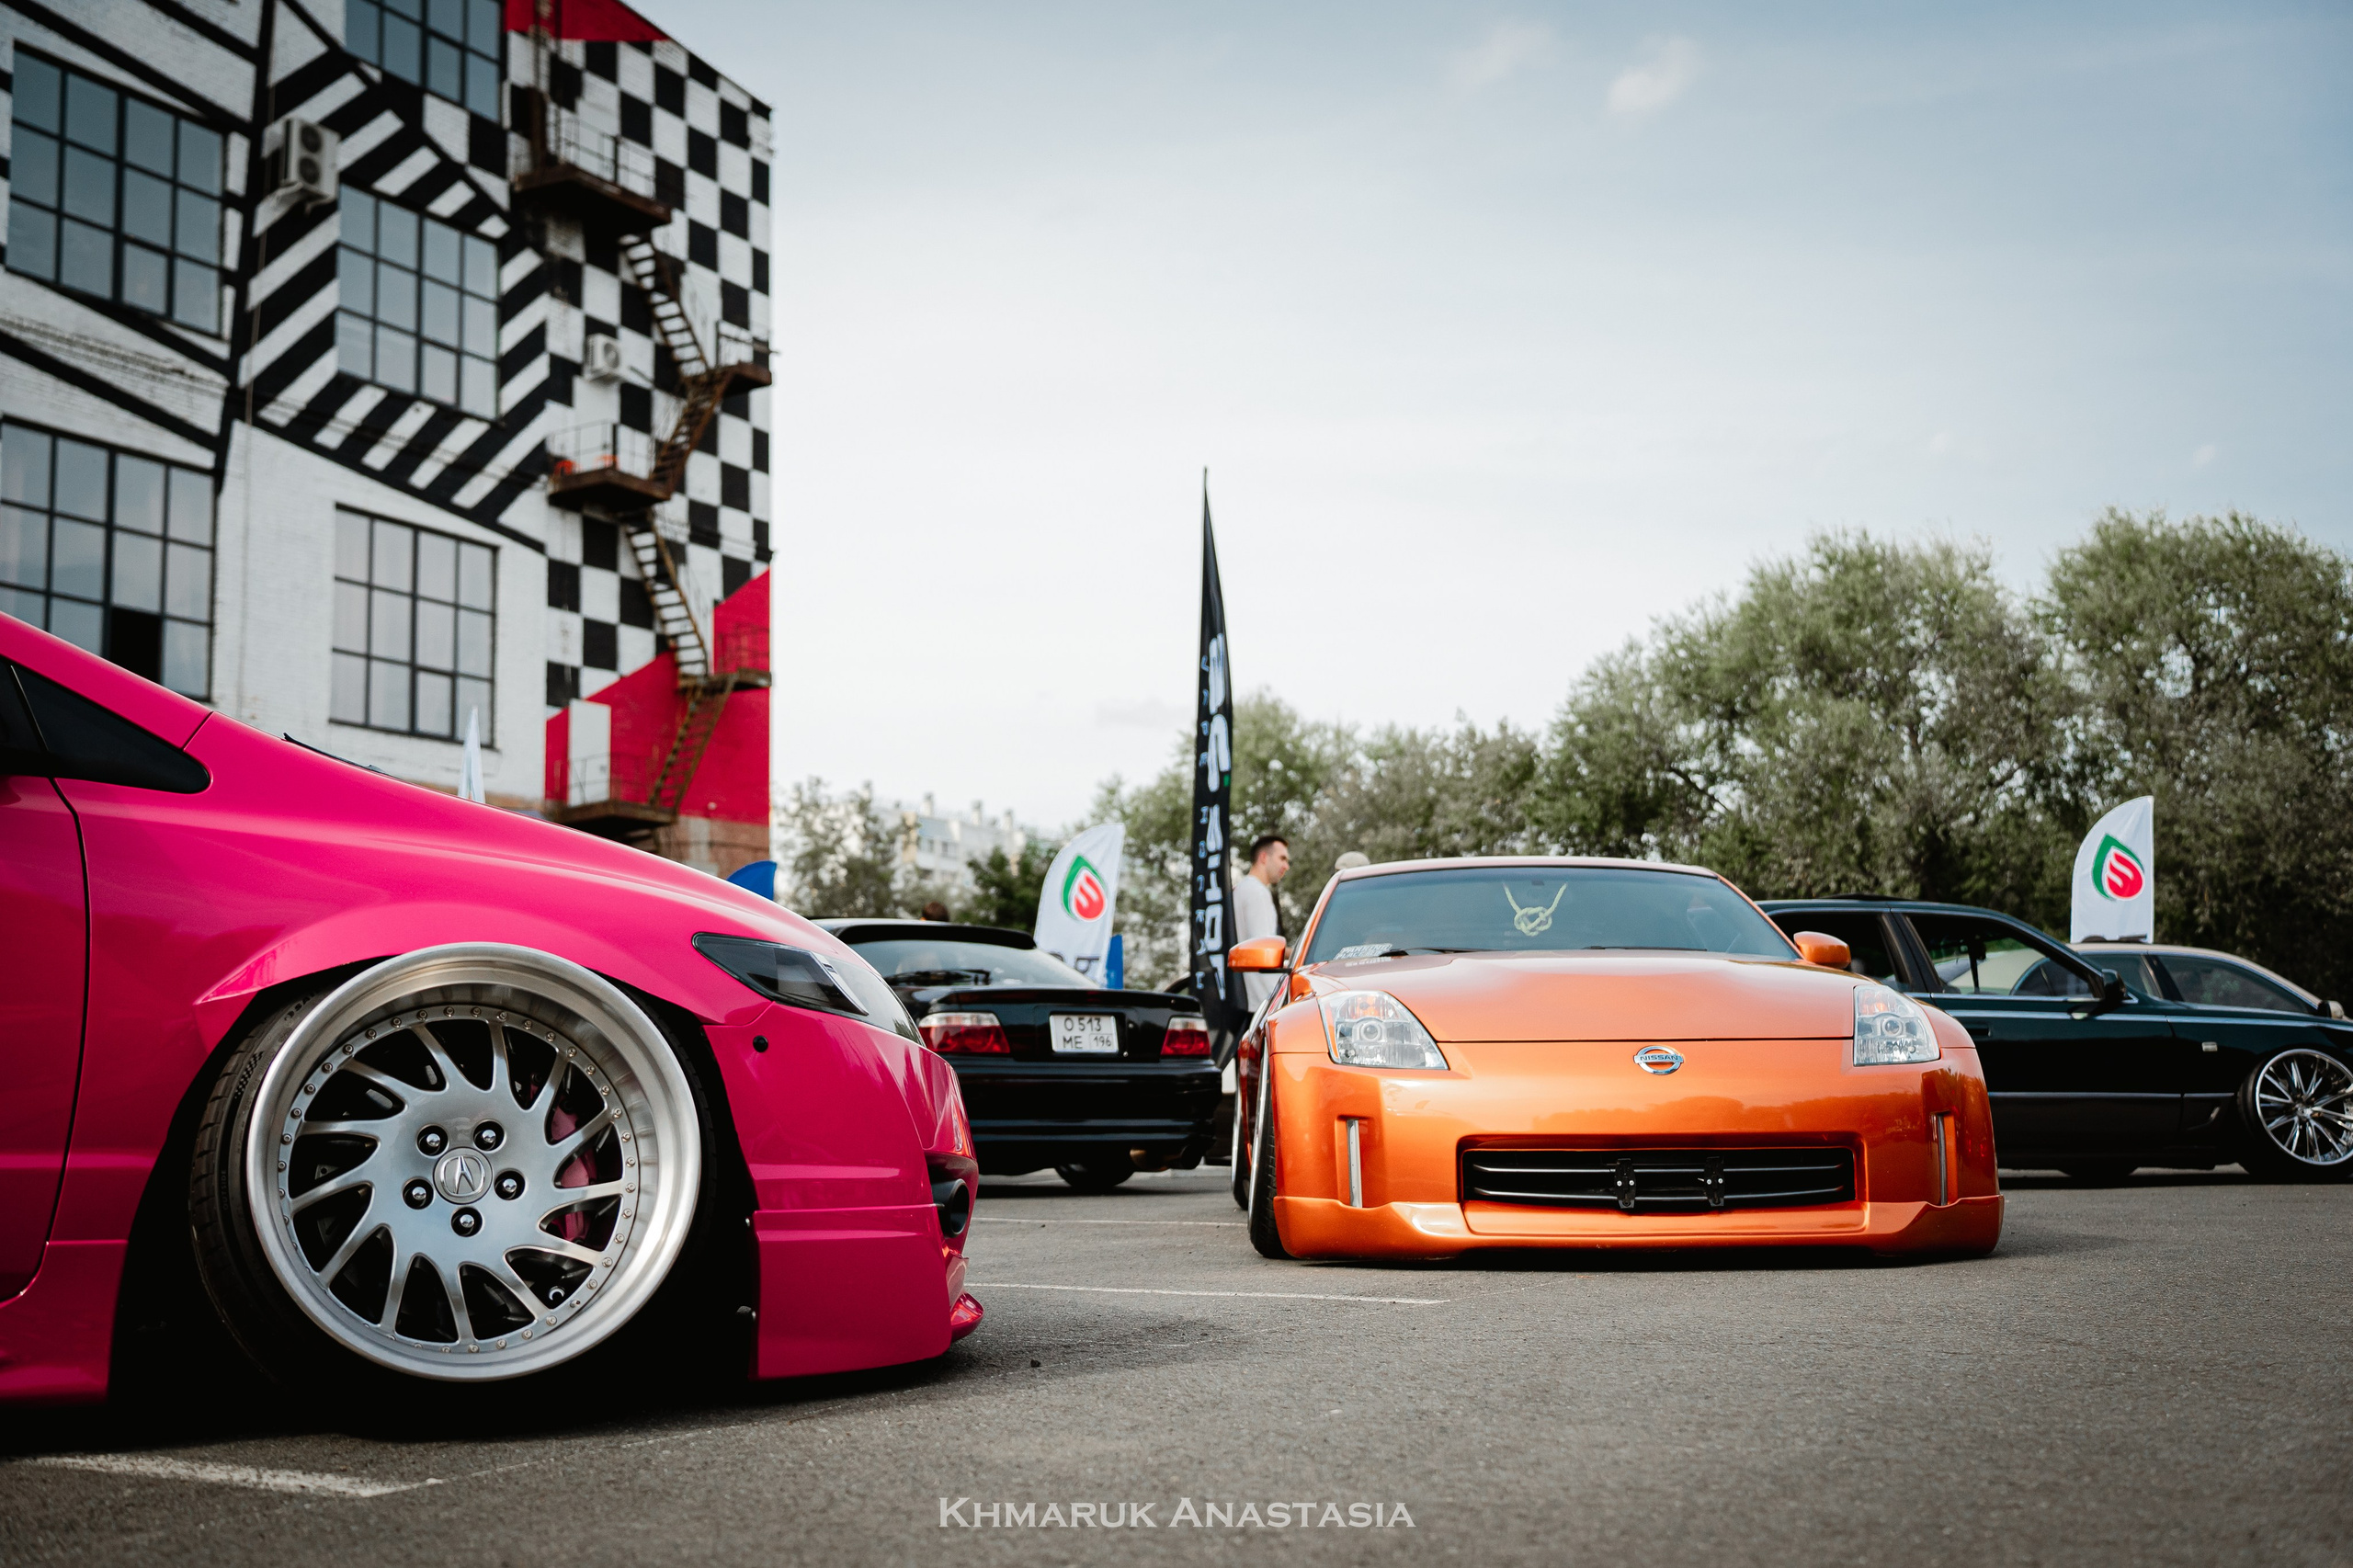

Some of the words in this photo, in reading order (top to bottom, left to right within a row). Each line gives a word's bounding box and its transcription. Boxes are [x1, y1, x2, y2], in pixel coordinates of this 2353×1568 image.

[1077, 1017, 1102, 1031] 513
[1063, 1035, 1083, 1049] ME
[1093, 1035, 1111, 1047] 196
